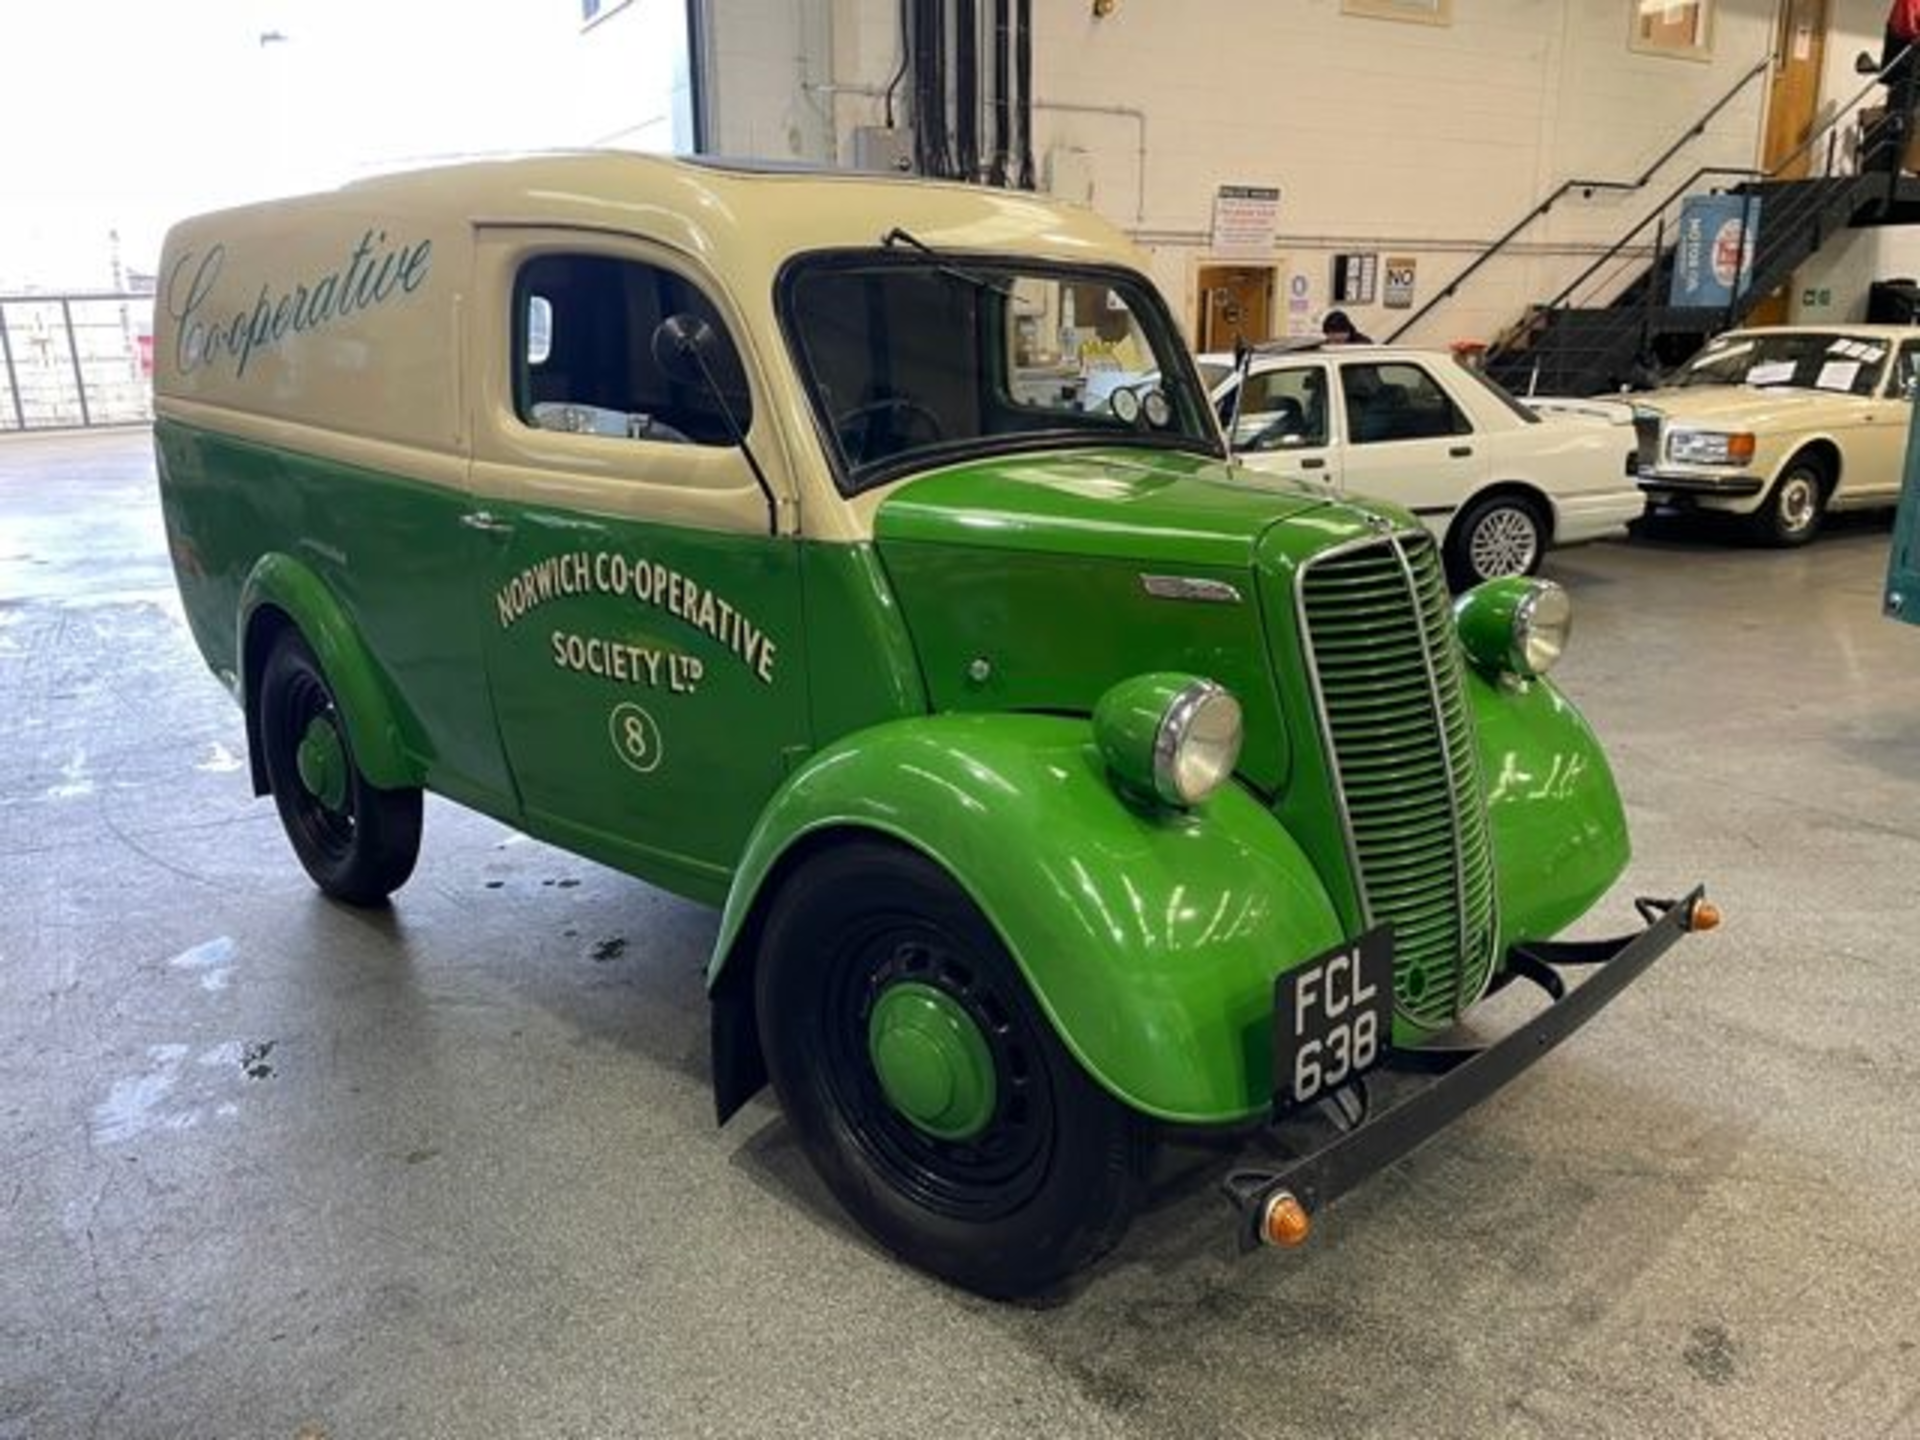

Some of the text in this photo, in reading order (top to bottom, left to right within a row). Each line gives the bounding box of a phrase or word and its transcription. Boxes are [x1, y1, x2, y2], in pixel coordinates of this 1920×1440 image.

[1388, 269, 1414, 286] NO
[496, 552, 591, 627] NORWICH
[551, 630, 662, 688] SOCIETY
[623, 716, 646, 757] 8
[1295, 947, 1377, 1036] FCL
[1295, 1010, 1378, 1102] 638
